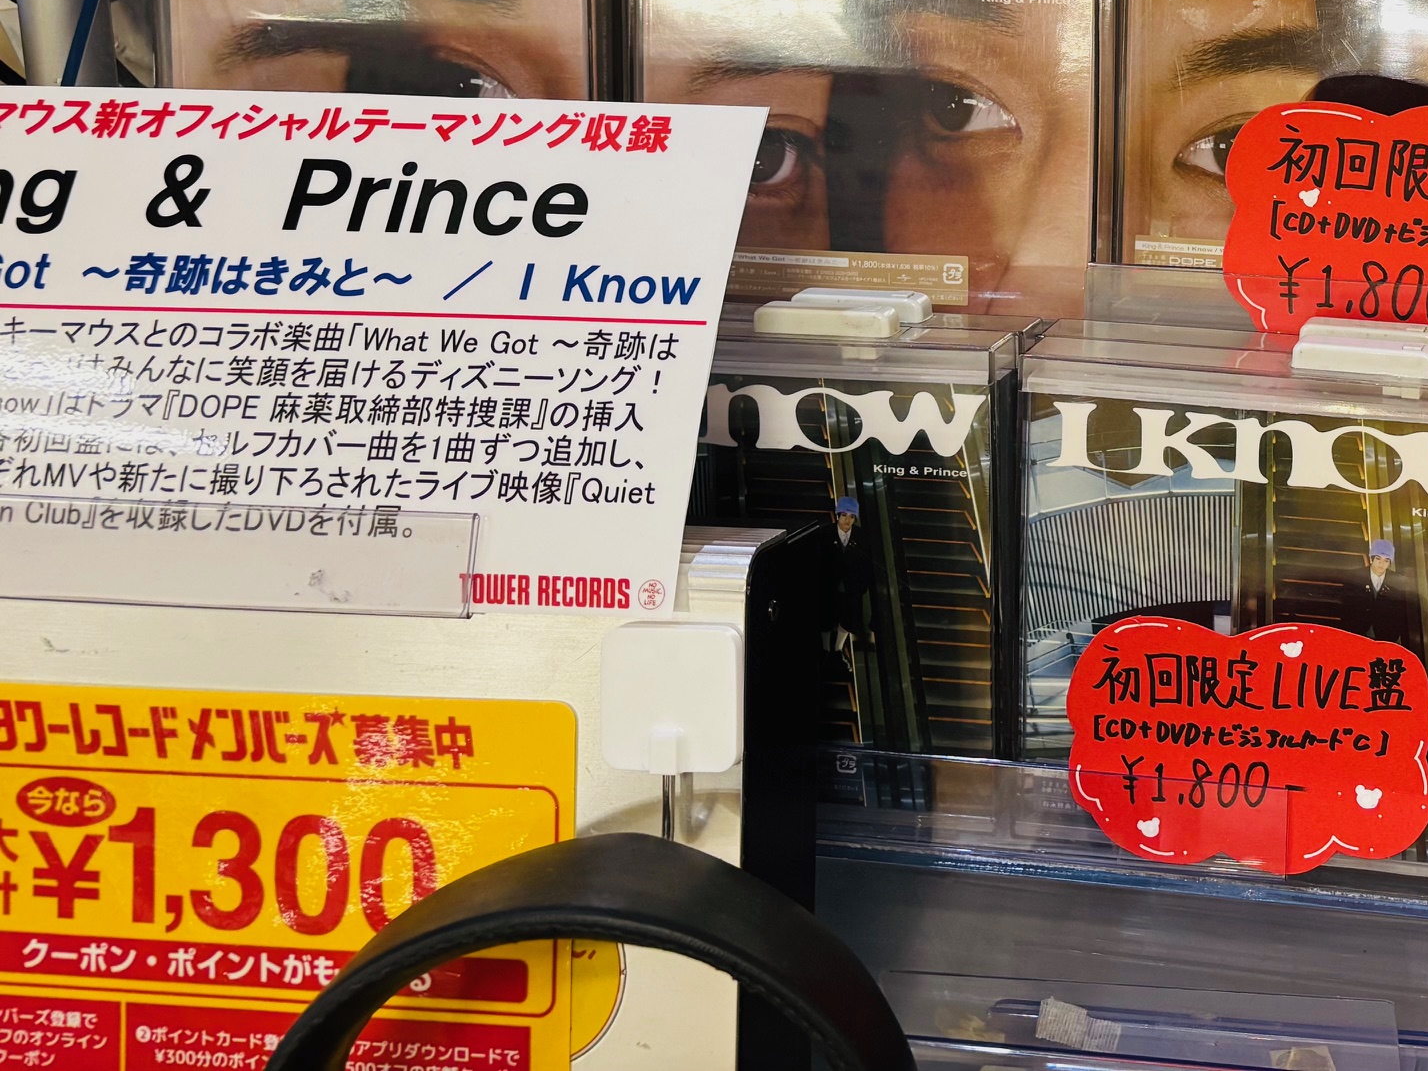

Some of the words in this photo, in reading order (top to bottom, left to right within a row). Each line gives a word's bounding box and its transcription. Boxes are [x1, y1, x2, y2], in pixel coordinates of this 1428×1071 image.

[144, 153, 212, 230] &
[283, 157, 590, 240] Prince
[518, 263, 534, 301] I
[562, 264, 700, 307] Know
[440, 329, 478, 353] We
[490, 330, 539, 355] Got
[698, 383, 987, 458] now
[873, 463, 905, 478] King
[909, 465, 920, 476] &
[923, 466, 968, 479] Prince
[459, 573, 531, 608] TOWER
[538, 575, 631, 610] RECORDS
[353, 714, 475, 770] 募集中
[26, 786, 107, 816] 今なら
[30, 806, 438, 935] ¥1,300
